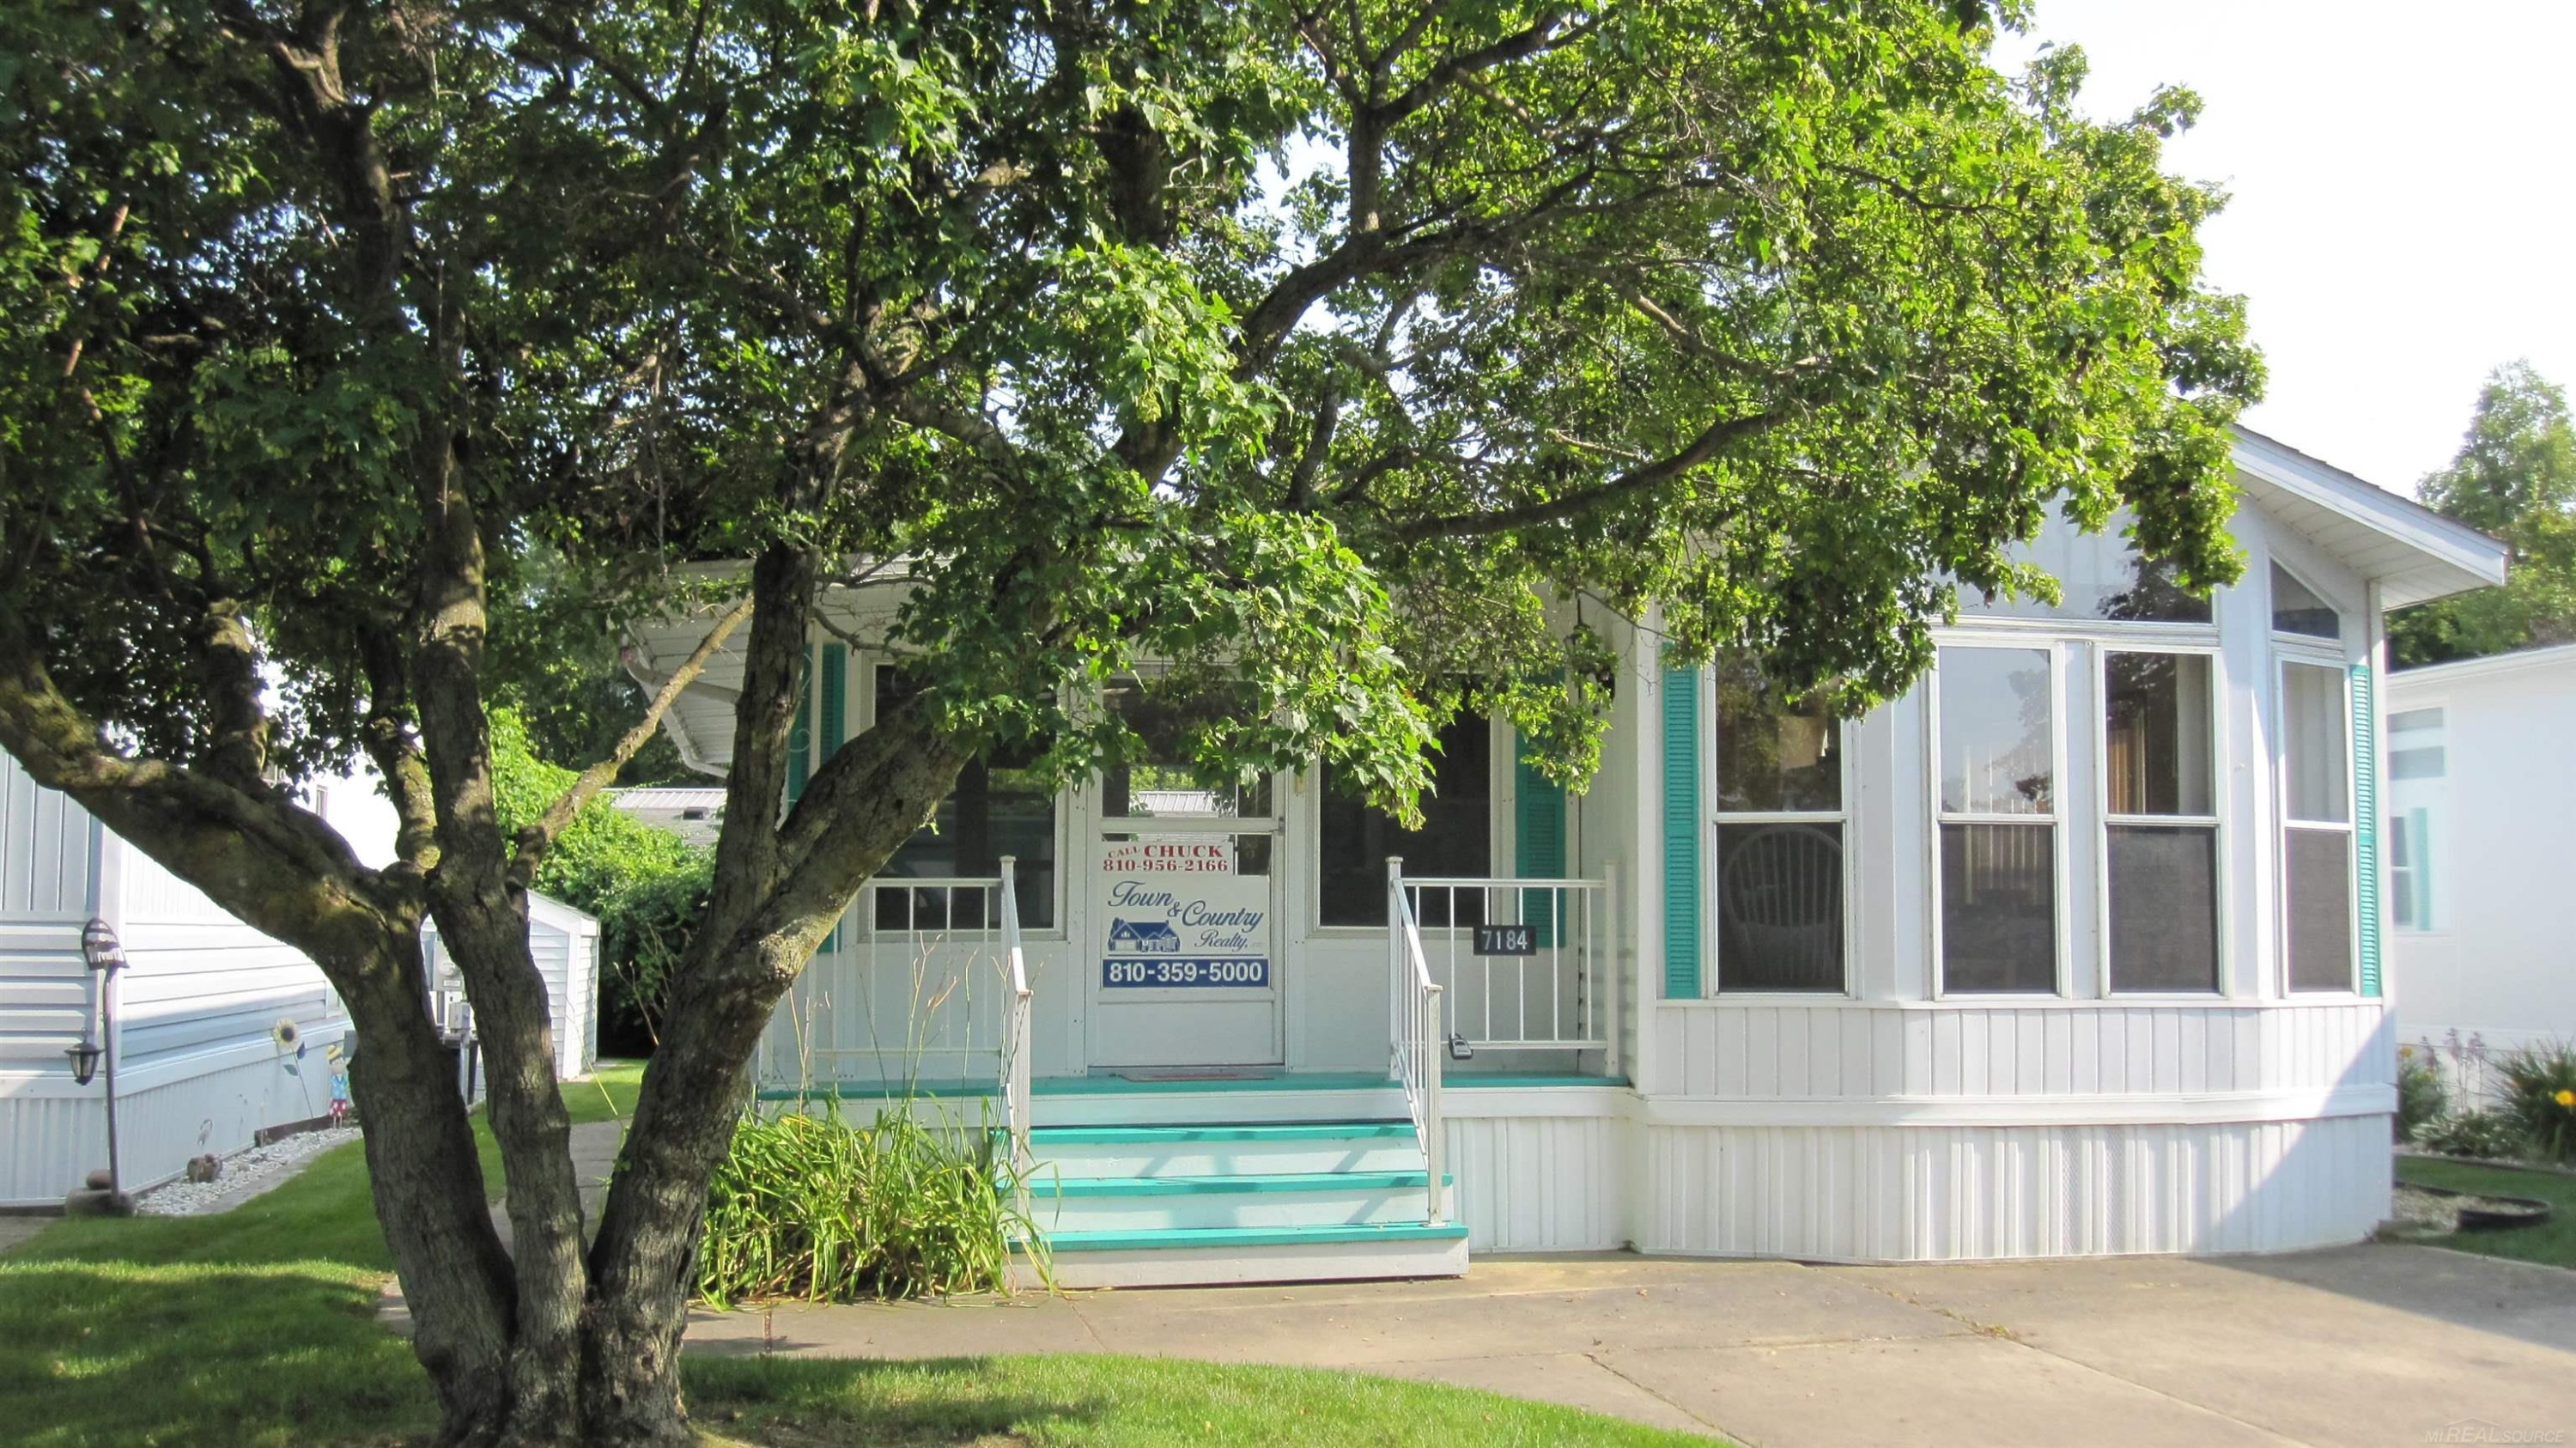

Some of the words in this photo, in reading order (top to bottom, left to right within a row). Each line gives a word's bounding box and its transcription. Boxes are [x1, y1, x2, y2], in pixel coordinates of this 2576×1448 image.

[1108, 846, 1140, 859] CALL
[1144, 845, 1223, 858] CHUCK
[1103, 860, 1228, 872] 810-956-2166
[1108, 880, 1174, 907] Town
[1167, 902, 1182, 917] &
[1182, 900, 1264, 933] Country
[1482, 930, 1528, 950] 7184
[1109, 962, 1262, 982] 810-359-5000
